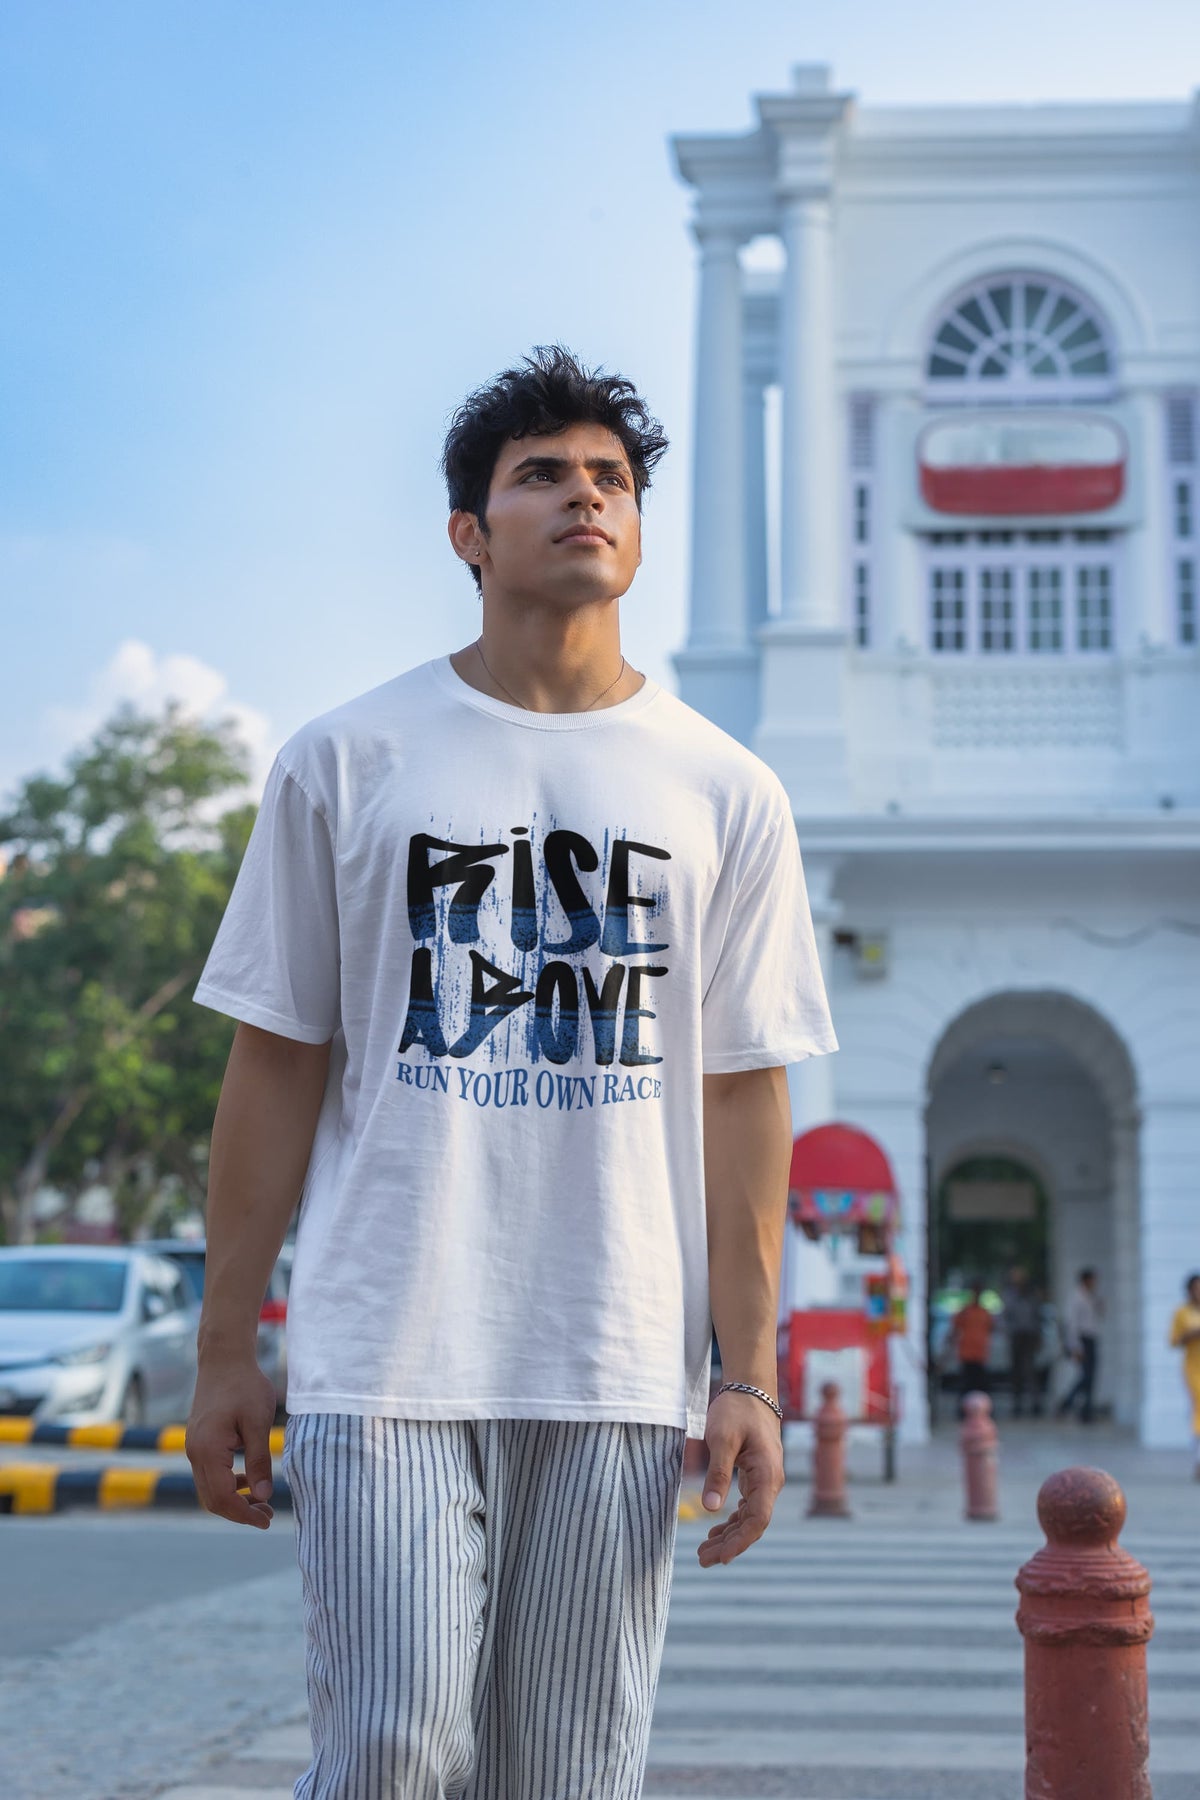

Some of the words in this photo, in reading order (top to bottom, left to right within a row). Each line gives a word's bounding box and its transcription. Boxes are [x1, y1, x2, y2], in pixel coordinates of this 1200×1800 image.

[397, 947, 669, 1067] ABOVE
[395, 1061, 452, 1094] RUN
[457, 1066, 529, 1108] YOUR
[535, 1069, 597, 1112] OWN
[601, 1073, 662, 1105] RACE
